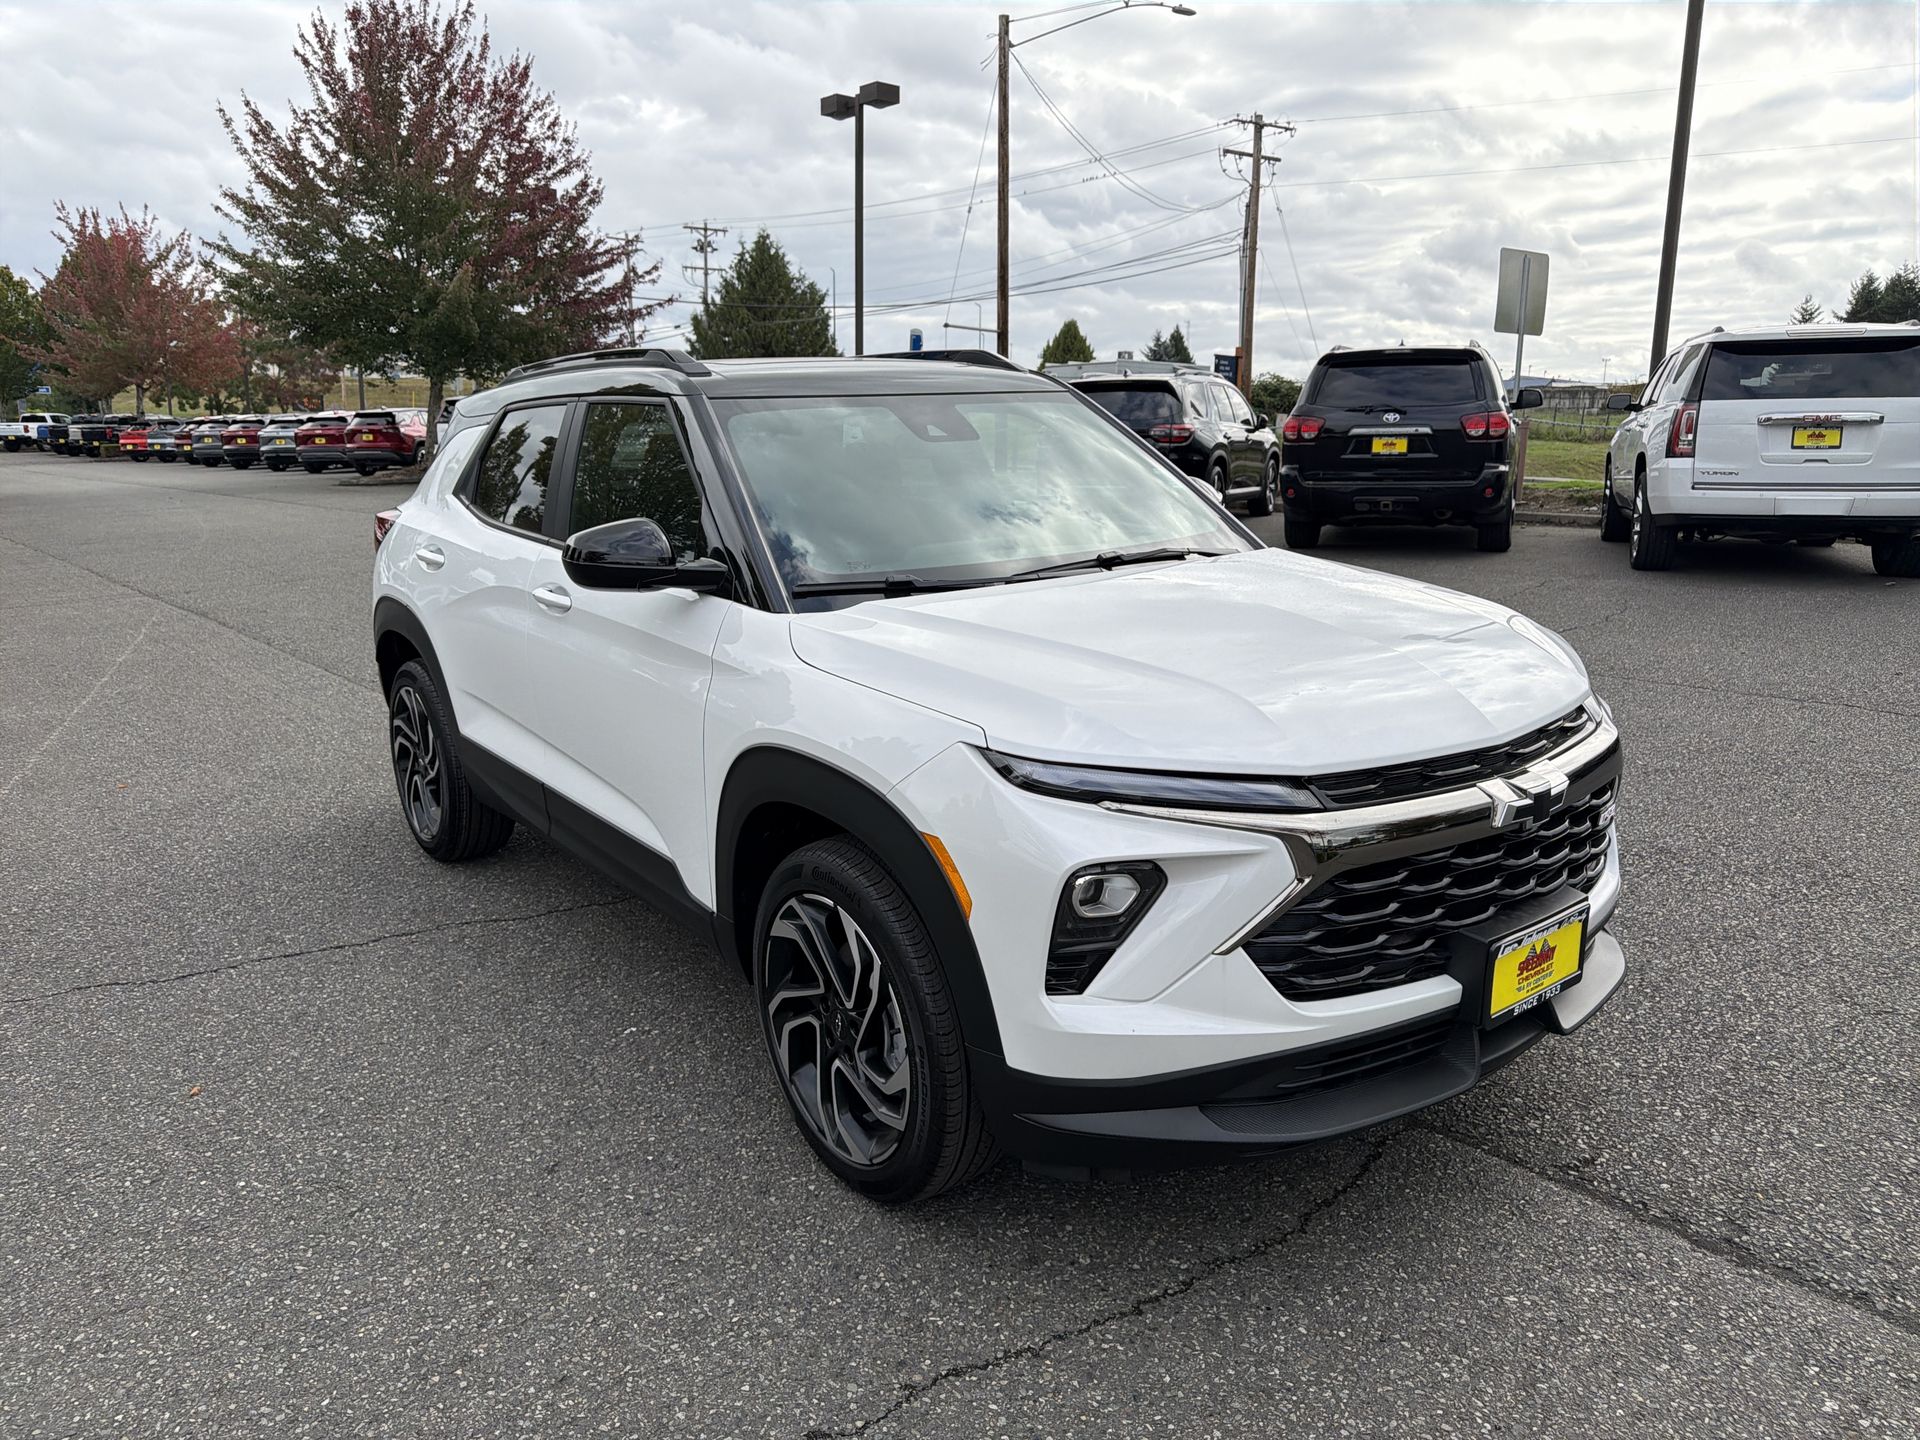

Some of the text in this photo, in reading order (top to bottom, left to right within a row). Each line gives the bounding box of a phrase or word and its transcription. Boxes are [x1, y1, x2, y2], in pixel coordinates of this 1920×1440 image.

[1802, 414, 1842, 423] GMC
[812, 865, 856, 903] Continental
[1518, 961, 1554, 985] CHEVROLET
[1513, 996, 1540, 1016] SINCE
[1541, 984, 1561, 1001] 1933
